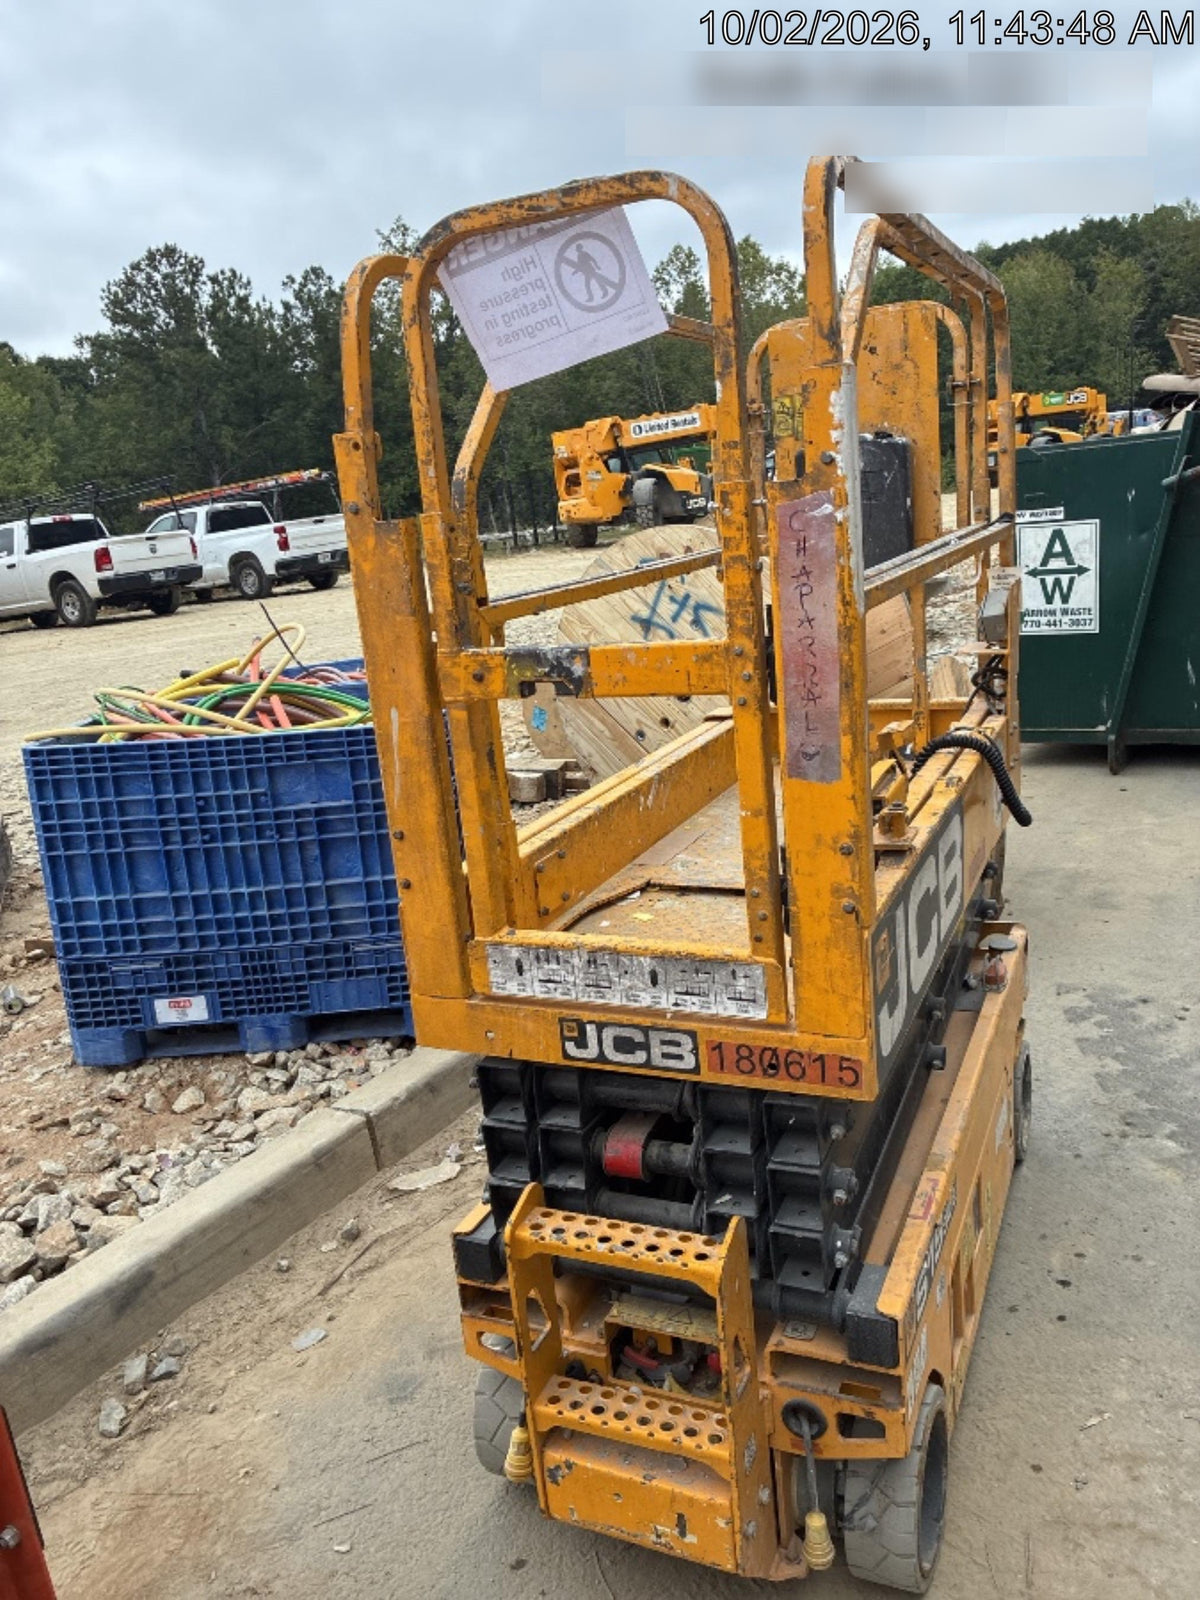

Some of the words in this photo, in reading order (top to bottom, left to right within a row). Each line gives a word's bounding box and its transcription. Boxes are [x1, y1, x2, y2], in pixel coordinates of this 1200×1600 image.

[1066, 391, 1088, 405] JCB
[1039, 527, 1076, 568] A
[1039, 575, 1077, 606] W
[1060, 606, 1093, 617] WASTE
[879, 813, 963, 1058] JCB
[564, 1022, 698, 1070] JCB
[710, 1041, 860, 1088] 180615
